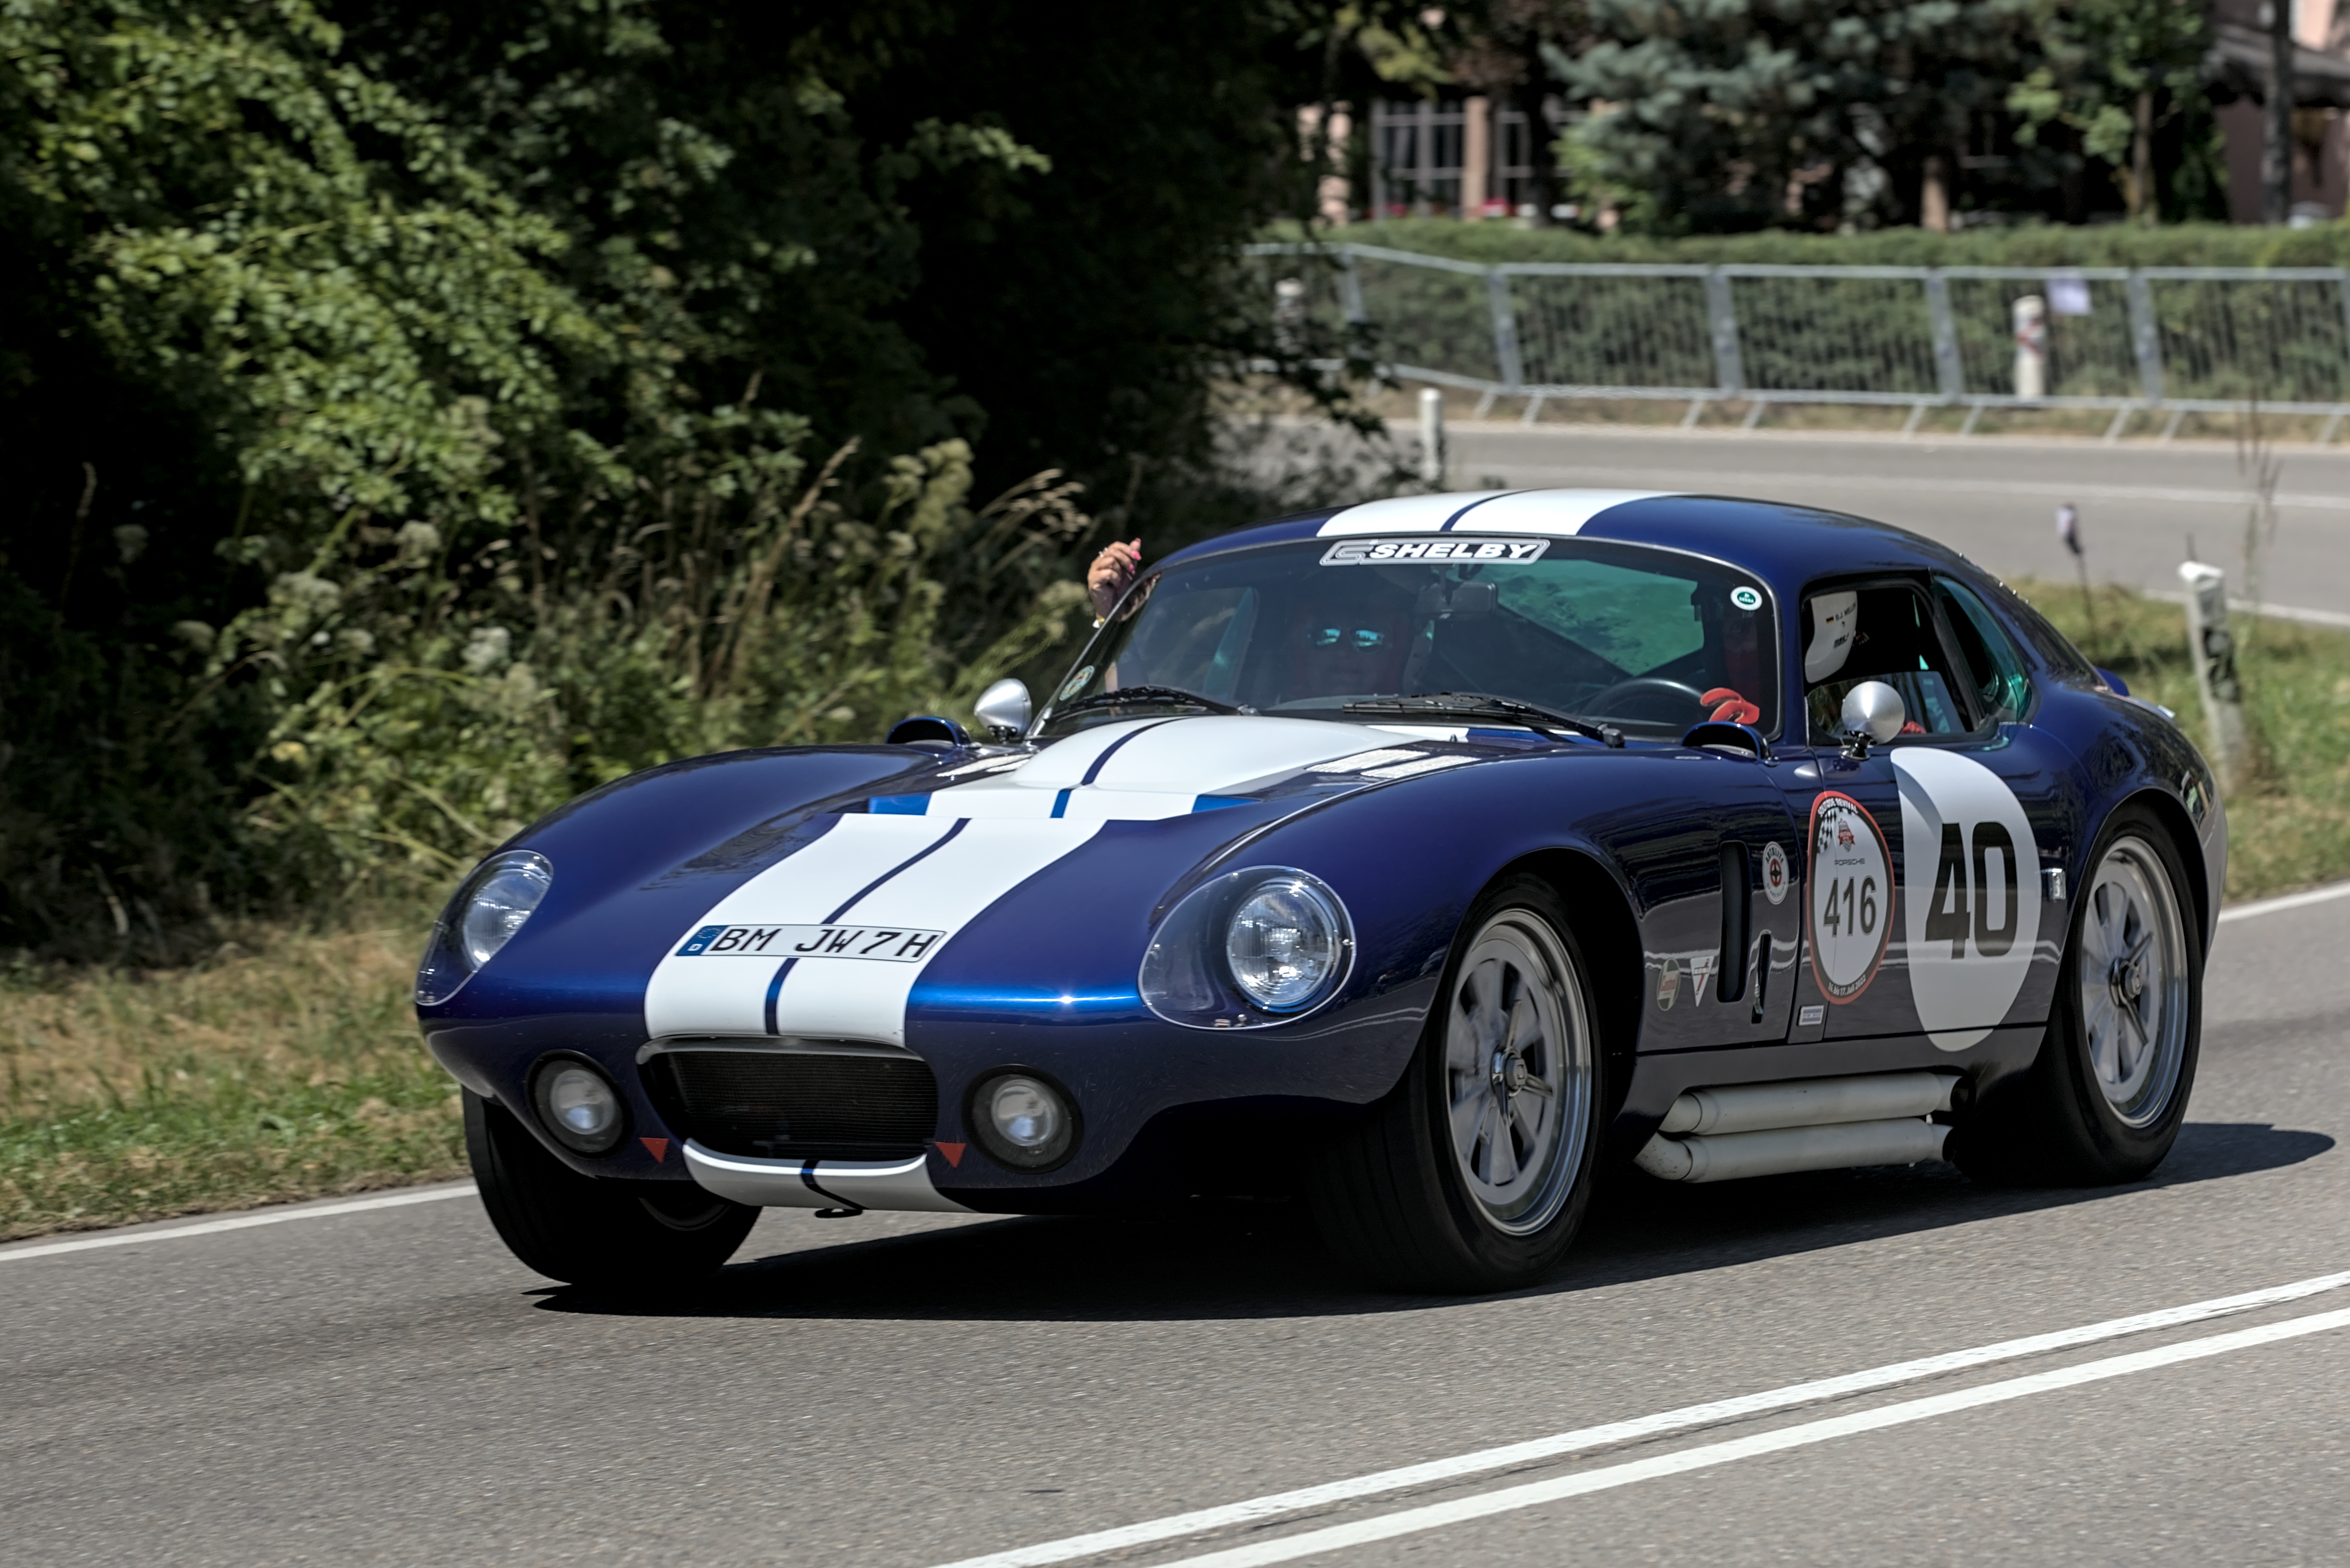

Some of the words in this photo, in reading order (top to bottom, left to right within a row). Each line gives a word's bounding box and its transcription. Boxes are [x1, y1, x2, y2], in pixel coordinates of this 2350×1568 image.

[1369, 543, 1539, 559] SHELBY
[1824, 875, 1877, 937] 416
[1925, 821, 2019, 959] 40
[709, 928, 783, 952] BM
